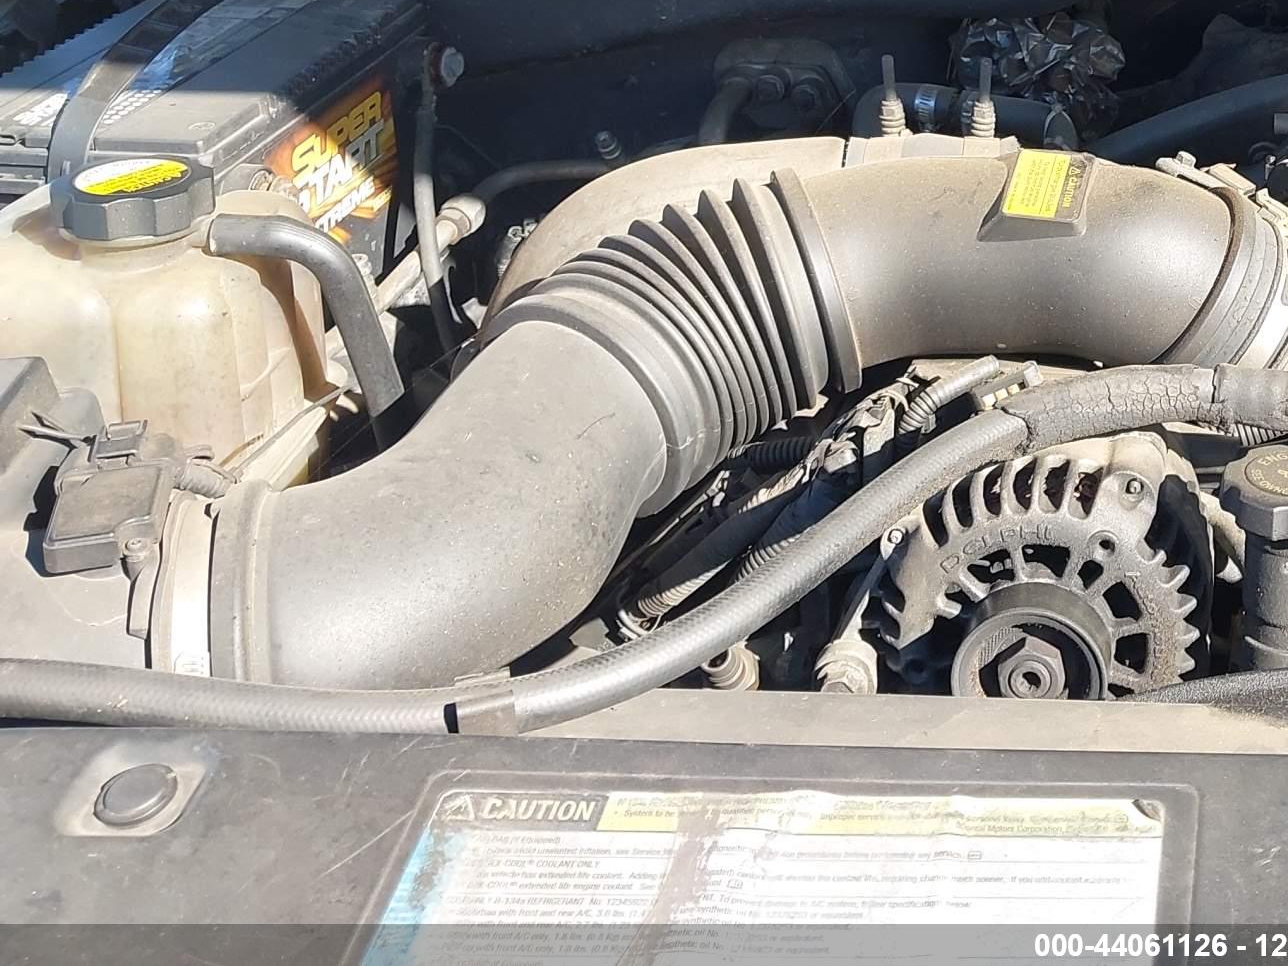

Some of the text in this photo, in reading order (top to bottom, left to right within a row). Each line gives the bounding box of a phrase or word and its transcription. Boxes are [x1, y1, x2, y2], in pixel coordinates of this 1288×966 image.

[291, 91, 382, 175] SUPER
[1062, 176, 1079, 208] CAUTION
[1251, 469, 1265, 481] SEE
[940, 524, 1050, 574] DELPHI
[482, 799, 598, 822] CAUTION
